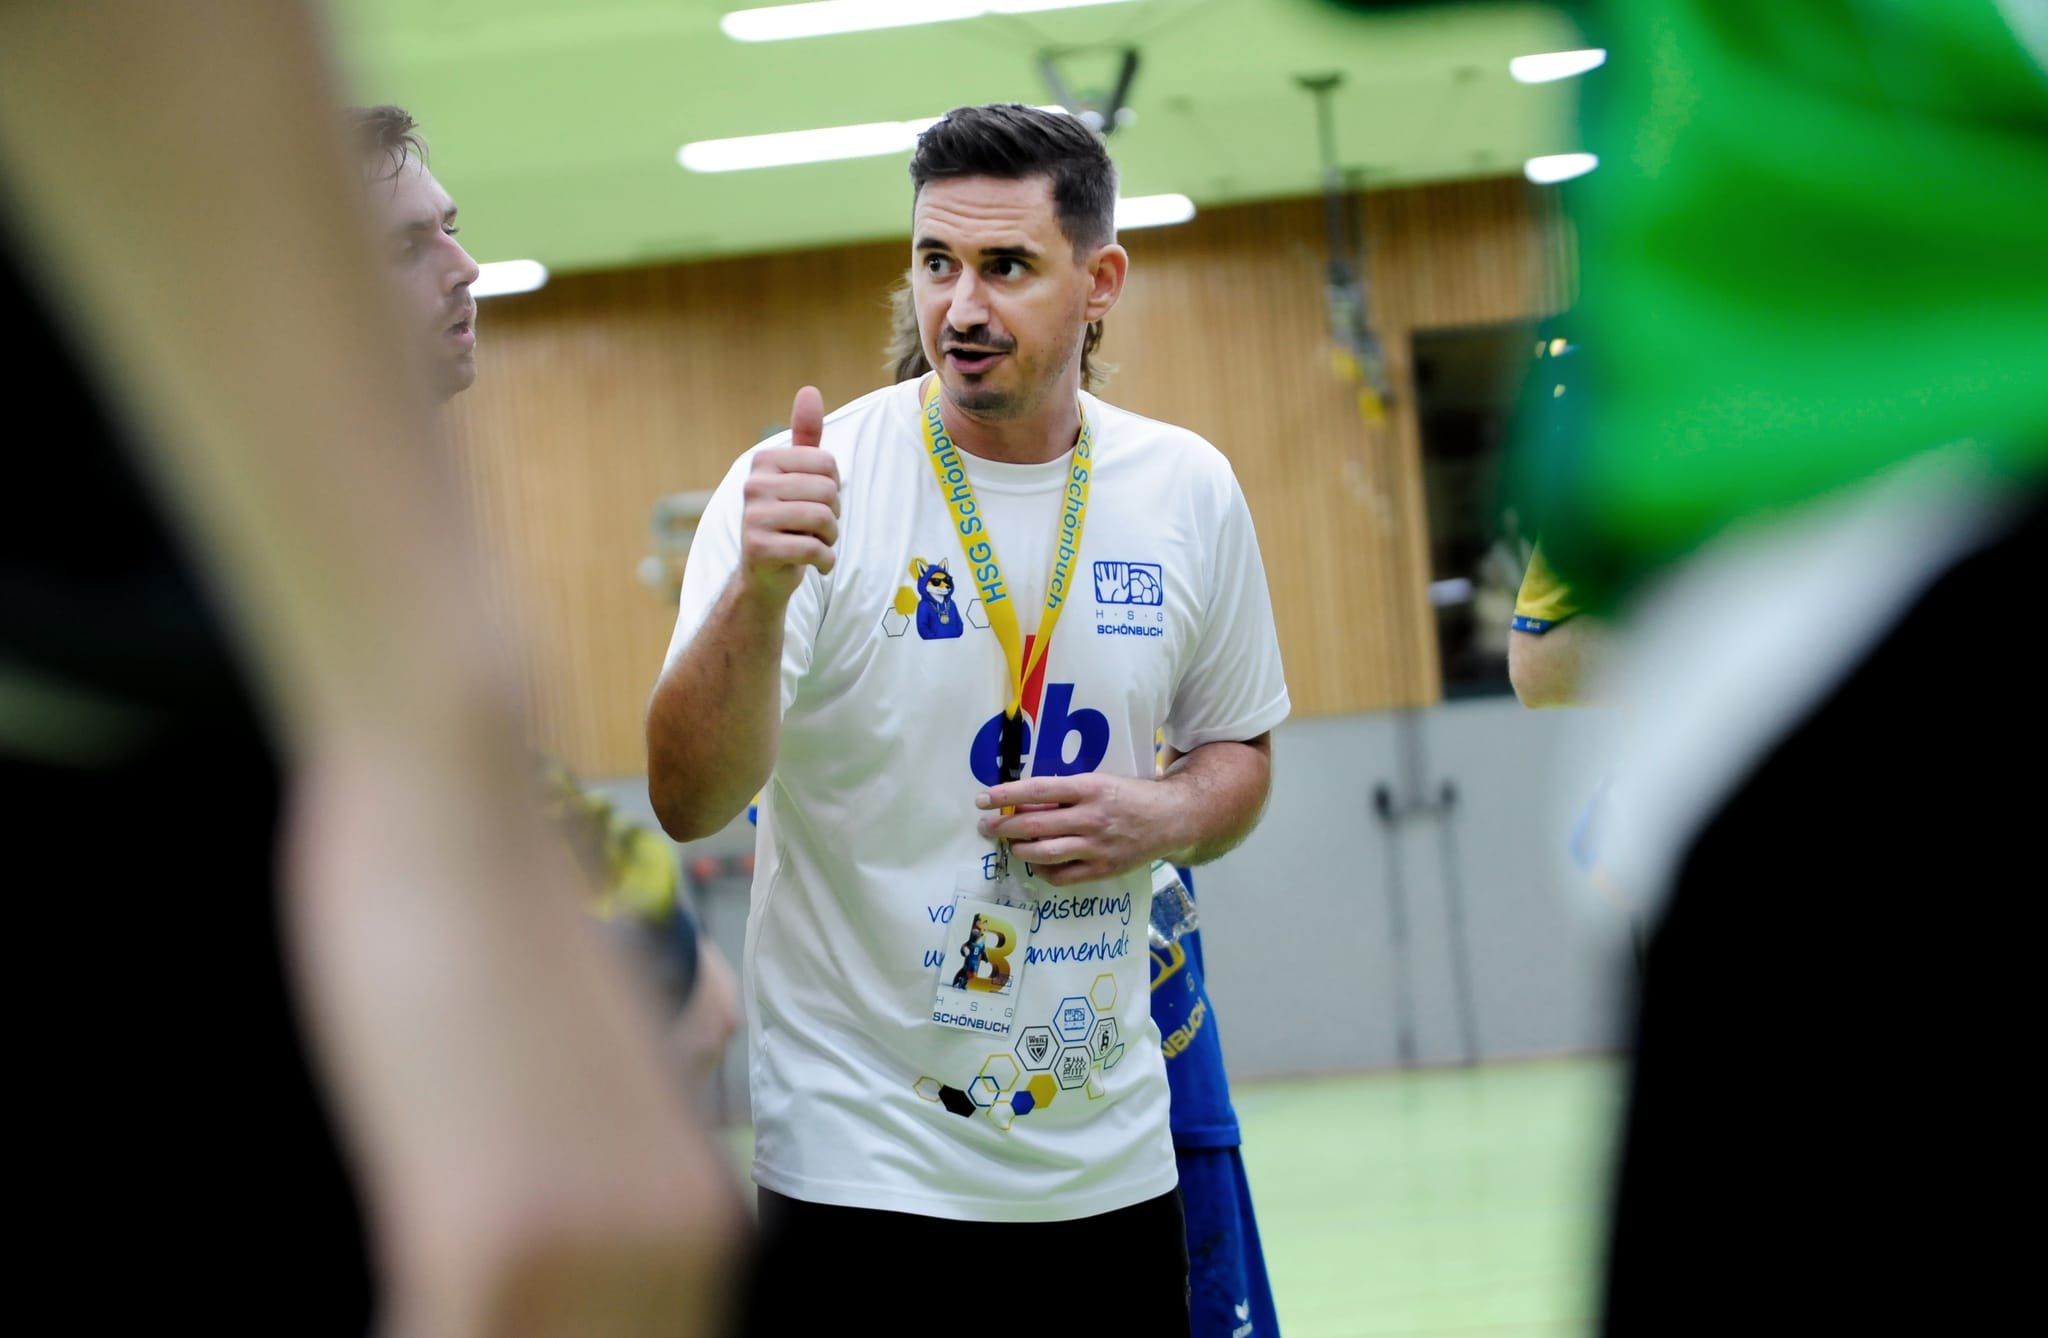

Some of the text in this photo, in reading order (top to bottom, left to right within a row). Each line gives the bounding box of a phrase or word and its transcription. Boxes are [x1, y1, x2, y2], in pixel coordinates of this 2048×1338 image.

[926, 396, 1007, 604] HSG Schönbuch
[1048, 420, 1091, 609] SG Schönbuch
[1097, 623, 1163, 637] SCHÖNBUCH
[1023, 930, 1130, 966] ammenhalt
[932, 1011, 1010, 1034] SCHÖNBUCH
